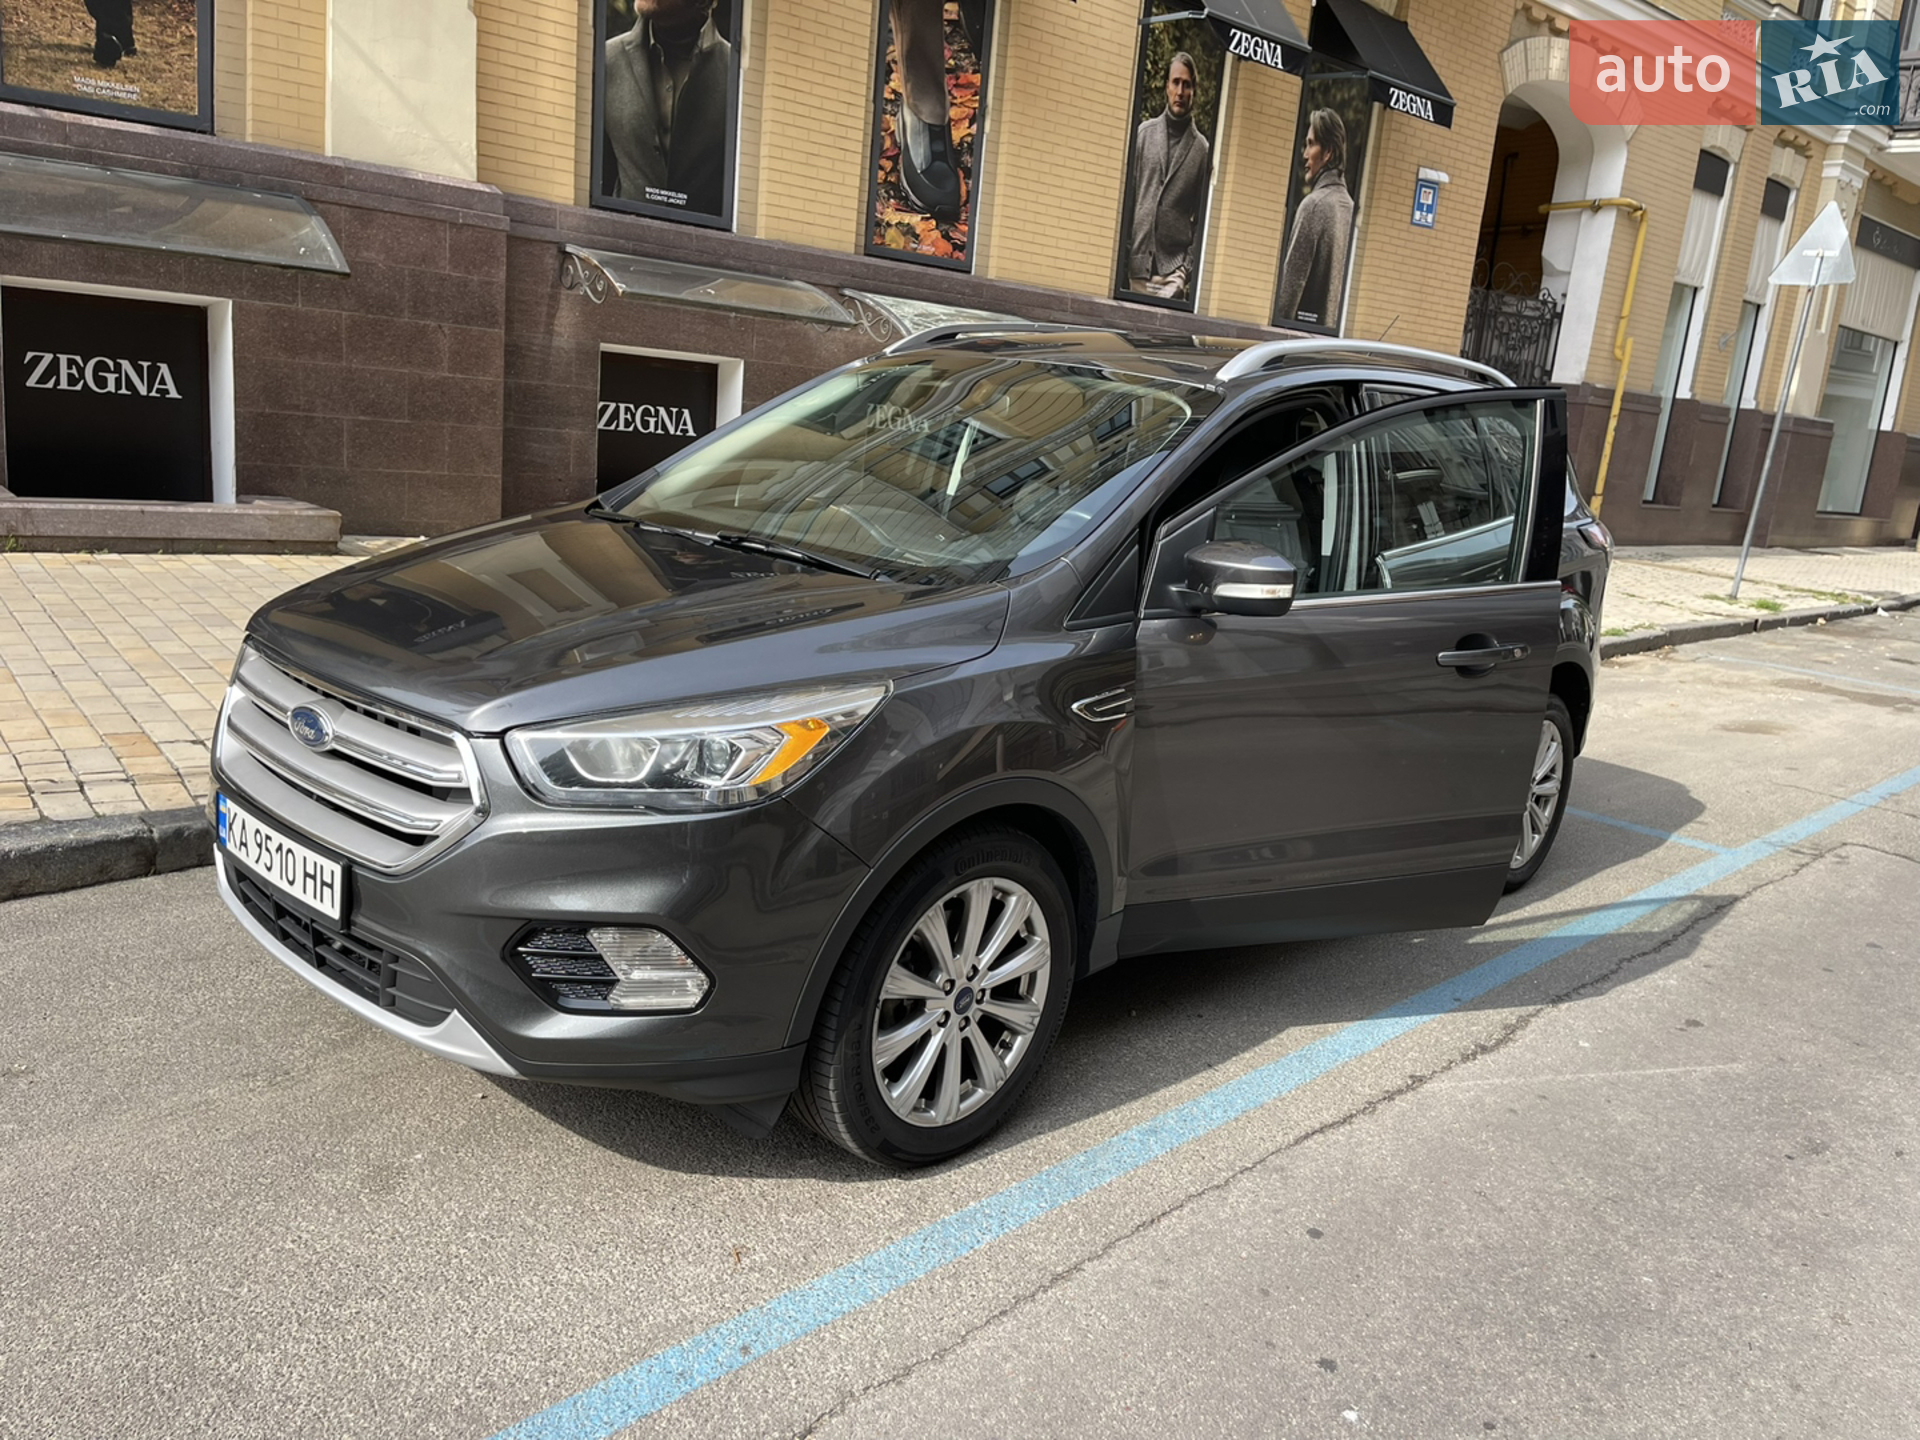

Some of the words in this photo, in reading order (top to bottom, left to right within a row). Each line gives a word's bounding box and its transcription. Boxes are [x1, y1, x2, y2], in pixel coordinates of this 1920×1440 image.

[1229, 28, 1284, 69] ZEGNA
[74, 76, 97, 86] MADS
[95, 87, 138, 101] CASHMERE
[1389, 87, 1434, 122] ZEGNA
[24, 351, 183, 399] ZEGNA
[597, 401, 697, 437] ZEGNA
[228, 807, 249, 858] KA
[254, 828, 296, 887] 9510
[303, 855, 334, 909] HH
[954, 847, 1024, 877] Continental
